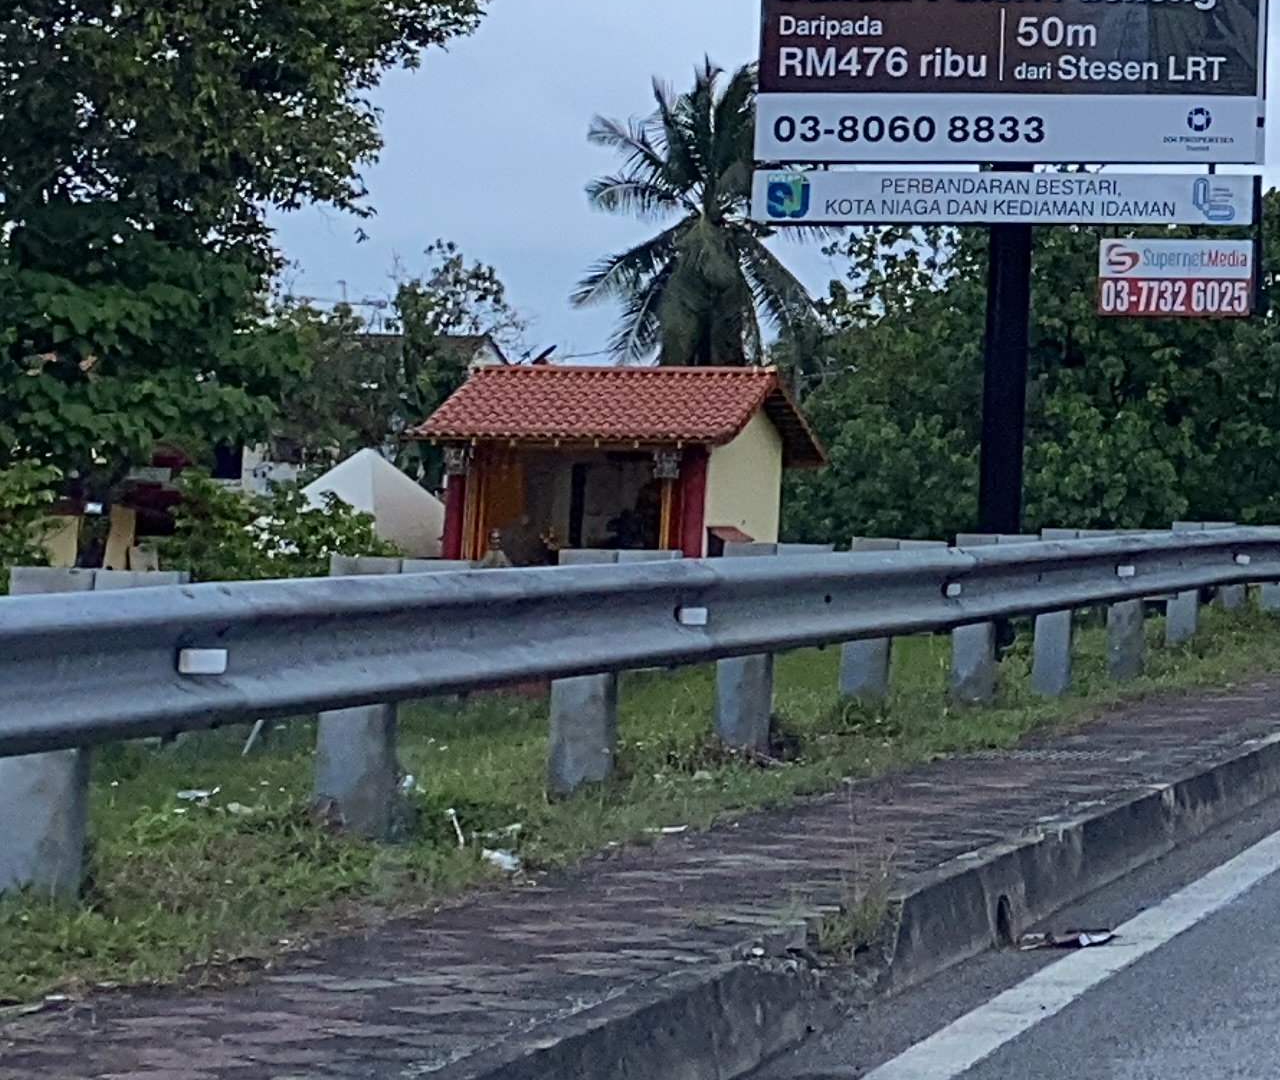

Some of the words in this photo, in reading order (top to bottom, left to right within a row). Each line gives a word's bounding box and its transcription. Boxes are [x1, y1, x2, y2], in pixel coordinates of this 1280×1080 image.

[779, 16, 883, 39] Daripada
[1016, 17, 1097, 48] 50m
[778, 47, 909, 78] RM476
[919, 47, 988, 79] ribu
[1014, 62, 1052, 81] dari
[1057, 55, 1159, 81] Stesen
[1168, 56, 1227, 81] LRT
[773, 116, 936, 143] 03-8060
[947, 116, 1046, 144] 8833
[880, 177, 1032, 196] PERBANDARAN
[1036, 179, 1123, 198] BESTARI,
[825, 199, 881, 216] KOTA
[883, 199, 943, 217] NIAGA
[946, 199, 988, 217] DAN
[993, 200, 1098, 218] KEDIAMAN
[1101, 201, 1177, 218] IDAMAN
[1101, 280, 1187, 312] 03-7732
[1191, 280, 1248, 312] 6025
